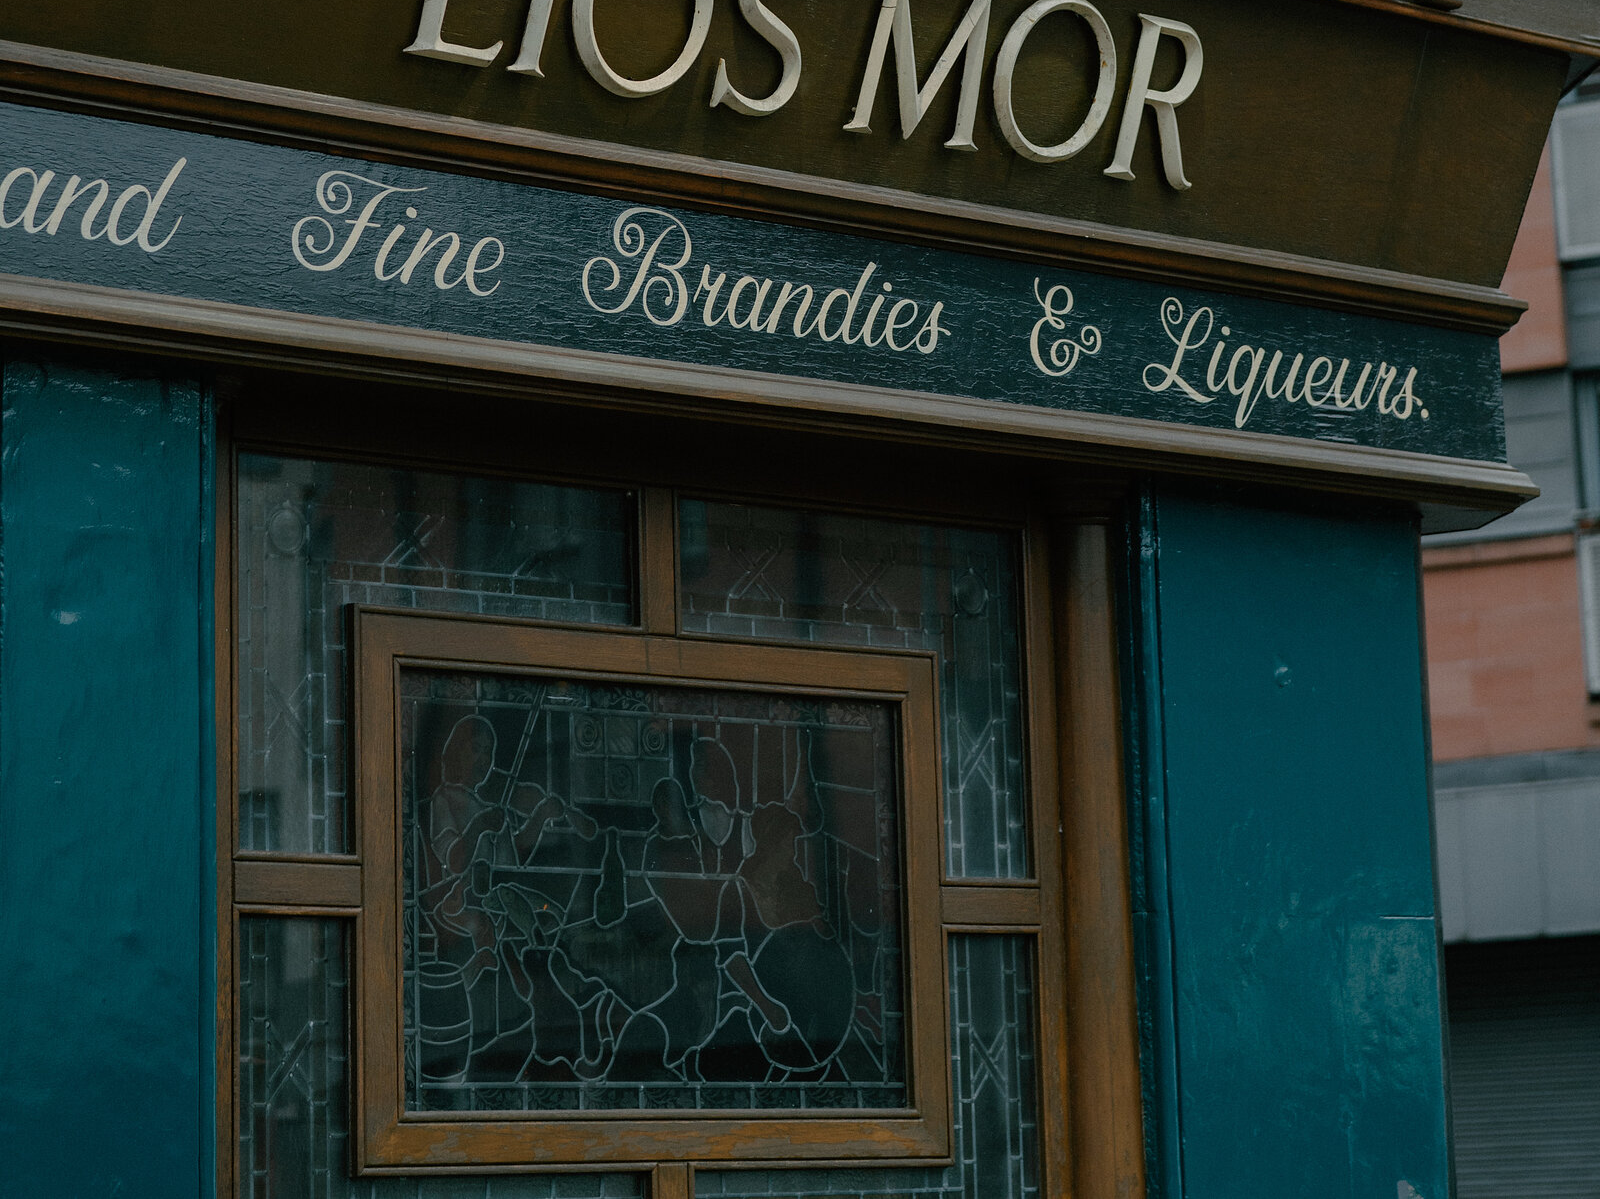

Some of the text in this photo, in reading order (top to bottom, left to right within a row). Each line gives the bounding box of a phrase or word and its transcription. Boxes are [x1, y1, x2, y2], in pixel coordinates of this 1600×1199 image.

[0, 157, 1430, 429] and Fine Brandies & Liqueurs.
